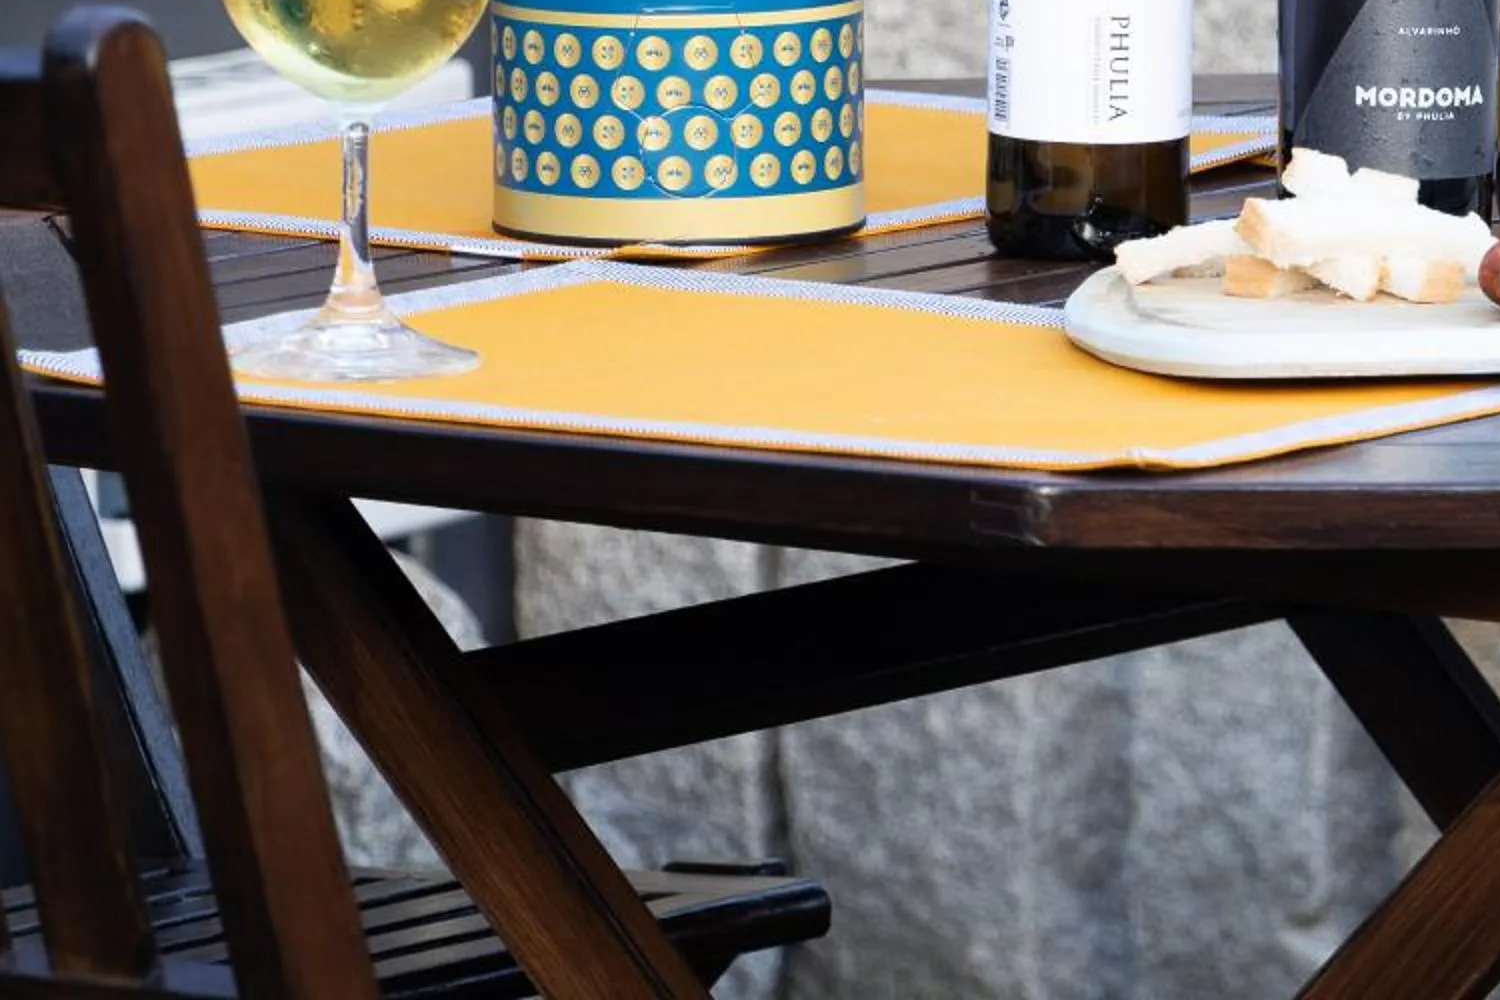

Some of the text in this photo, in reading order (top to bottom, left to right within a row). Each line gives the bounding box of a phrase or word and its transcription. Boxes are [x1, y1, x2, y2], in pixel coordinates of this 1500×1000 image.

[1398, 25, 1461, 36] ALVARINHO
[1108, 16, 1131, 121] PHULIA
[1355, 85, 1484, 108] MORDOMA
[1416, 111, 1455, 121] PHULIA
